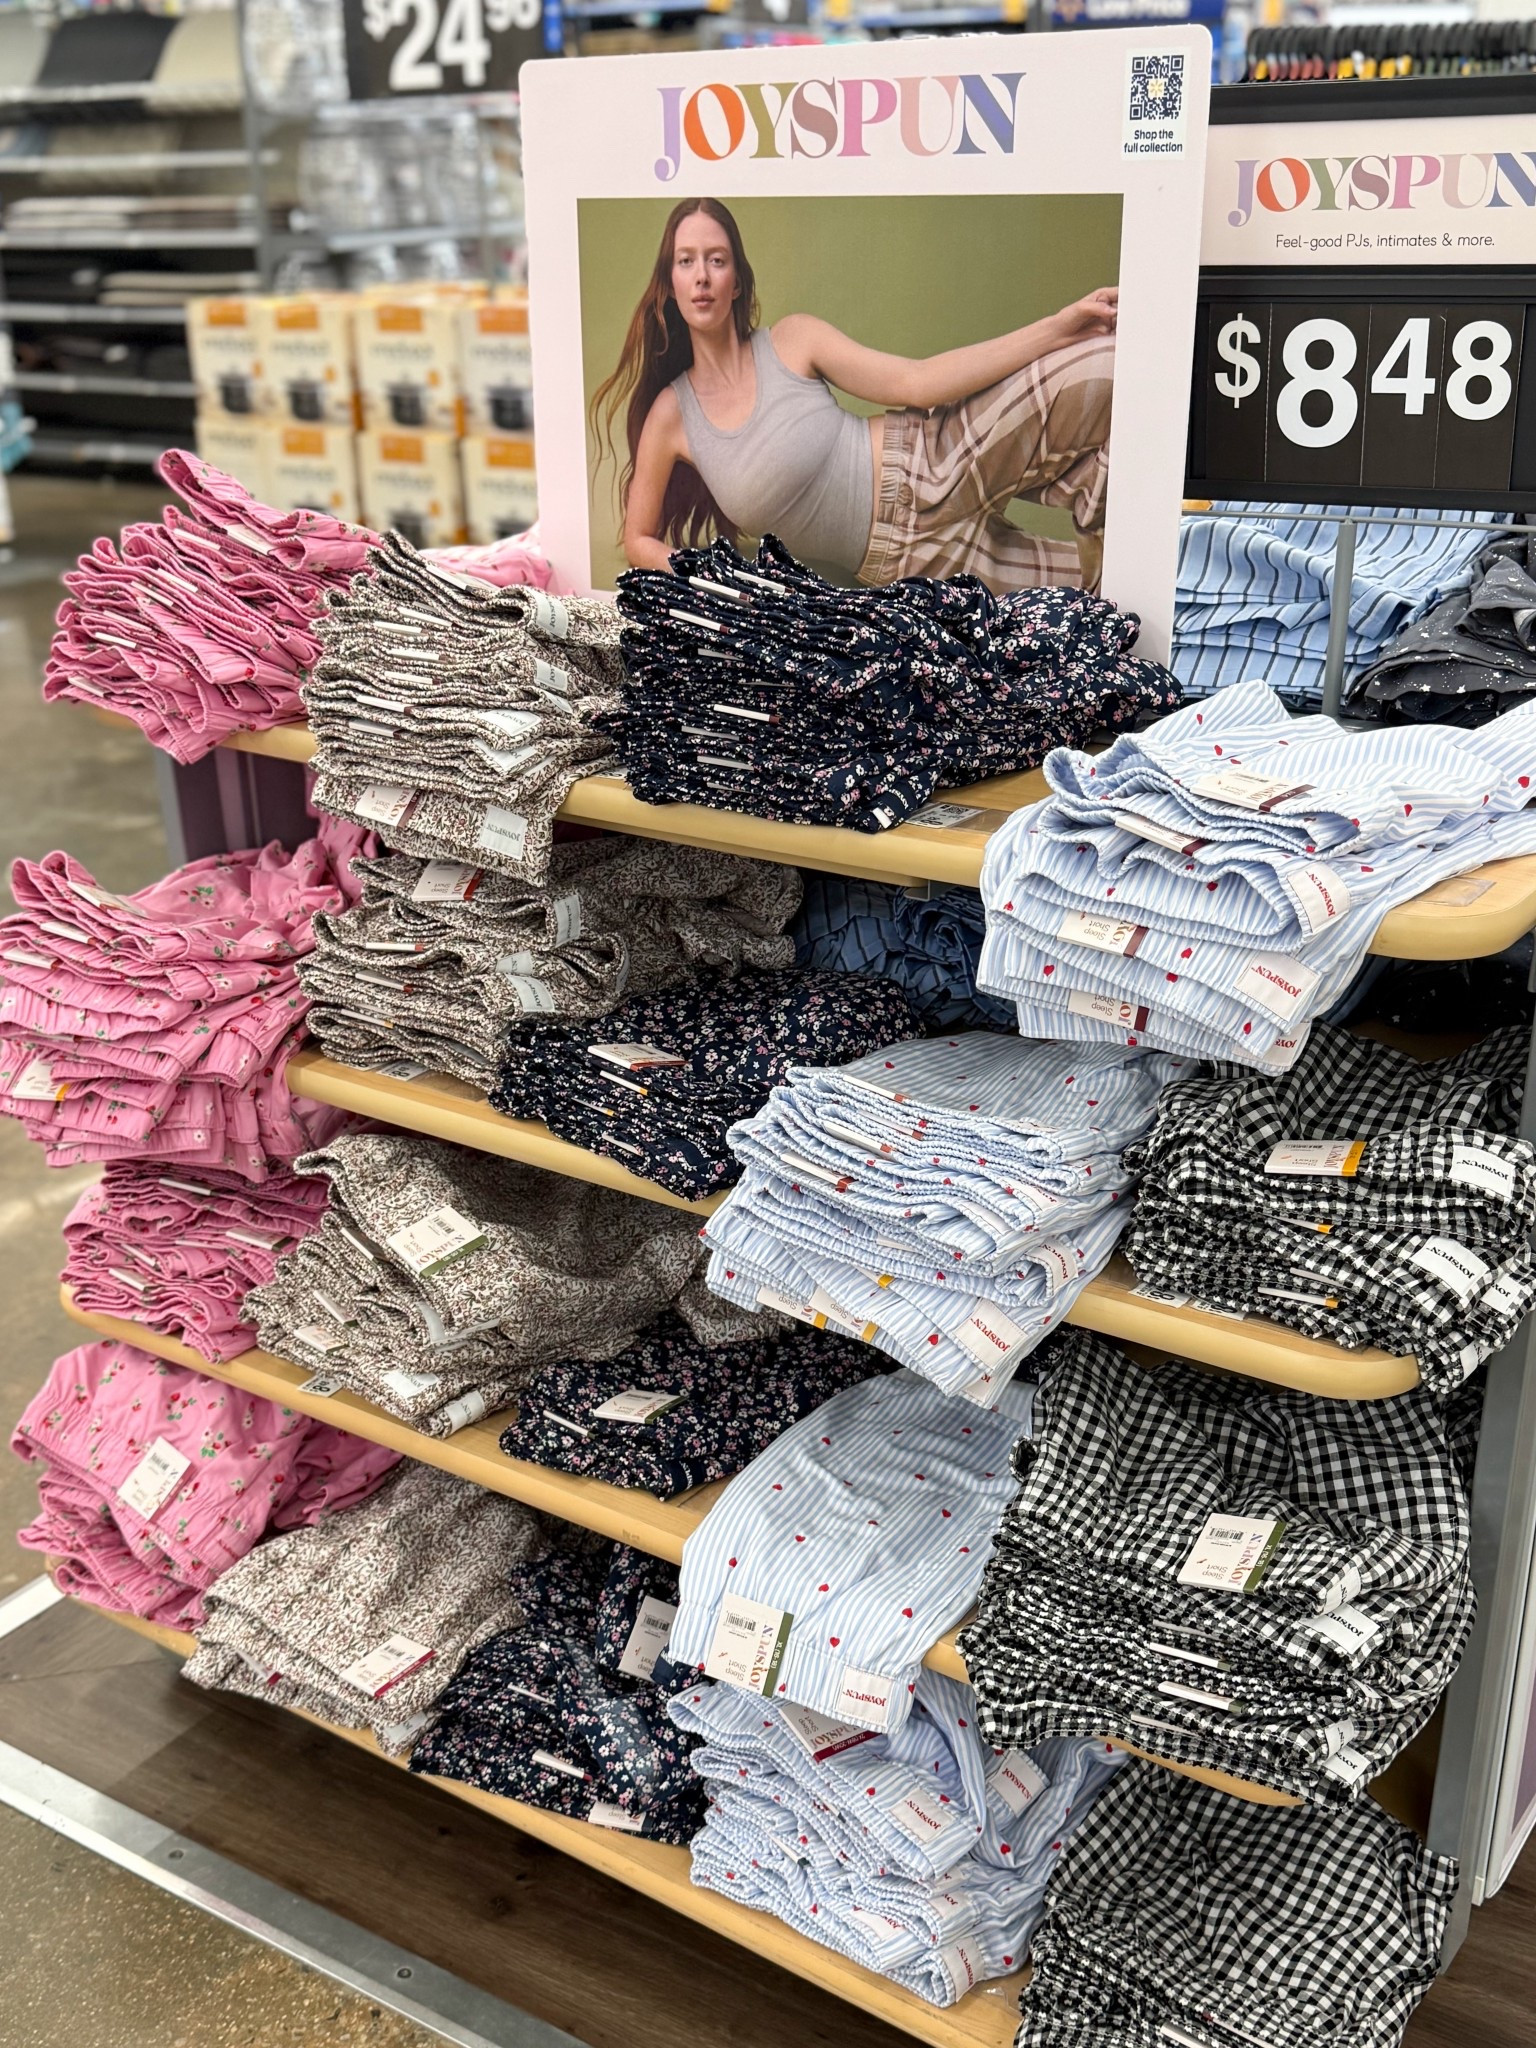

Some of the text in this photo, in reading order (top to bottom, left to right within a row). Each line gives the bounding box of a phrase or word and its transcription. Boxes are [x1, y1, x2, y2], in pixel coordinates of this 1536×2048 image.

[654, 72, 1027, 182] JOYSPUN
[1133, 129, 1174, 142] Shop the
[1123, 141, 1183, 155] full collection
[1228, 152, 1536, 228] JOYSPUN
[1275, 233, 1495, 251] Feel-good PJs, intimates & more.
[487, 823, 520, 842] JOYSPUN
[1307, 872, 1337, 917] JOYSPUN
[1084, 928, 1106, 941] Sleep
[1089, 920, 1111, 932] Short
[1254, 965, 1302, 998] JOYSPUN
[1091, 1002, 1114, 1016] Sleep
[1094, 995, 1115, 1007] Short
[1461, 1159, 1509, 1181] JOYSPUN
[1430, 1246, 1475, 1280] JOYSPUN
[778, 1295, 797, 1310] Sleep
[830, 1303, 848, 1319] Sleep
[973, 1317, 1011, 1353] JOYSPUN
[1229, 1533, 1264, 1585] JOYSPUN
[1202, 1570, 1224, 1580] Sleep
[1206, 1563, 1228, 1575] Short
[1326, 1613, 1364, 1637] JOYSPU
[728, 1659, 747, 1673] Short
[749, 1625, 774, 1691] JOYSPUN
[725, 1667, 744, 1682] Sleep
[846, 1688, 887, 1707] JOYSPUN
[798, 1719, 811, 1734] Sleep
[805, 1716, 819, 1732] Short
[1001, 1767, 1031, 1799] JOYSPUN
[906, 1801, 942, 1830] JOYSPUN
